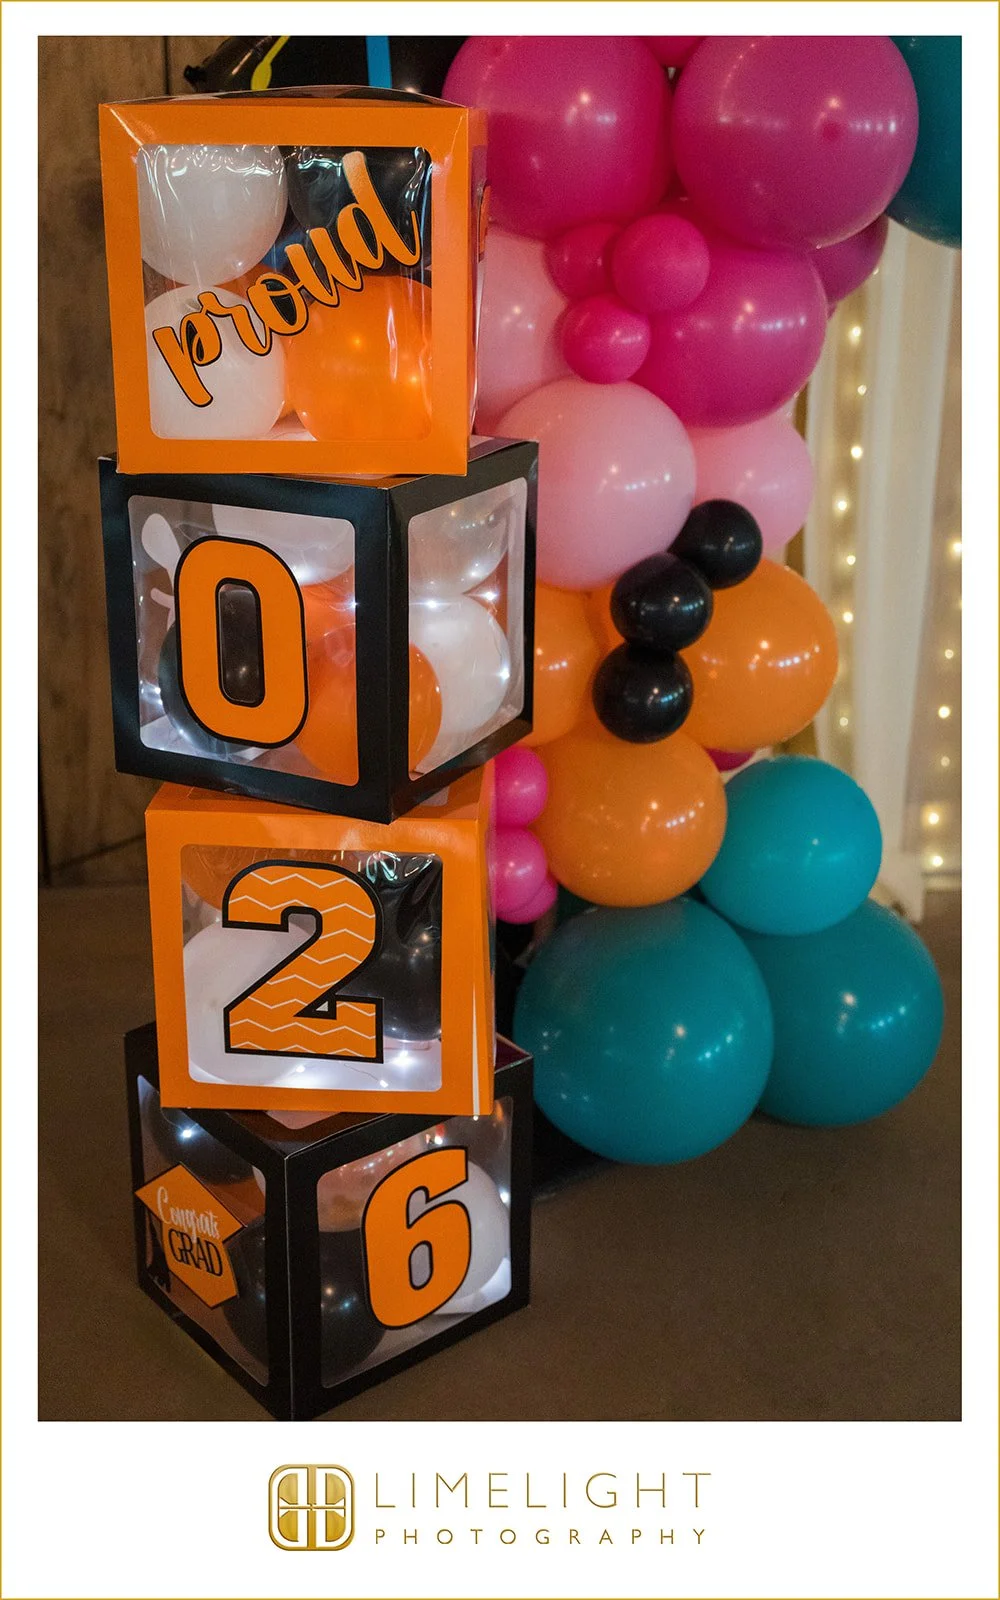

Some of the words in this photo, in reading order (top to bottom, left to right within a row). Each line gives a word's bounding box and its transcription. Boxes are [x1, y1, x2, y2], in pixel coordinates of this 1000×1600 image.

[152, 151, 421, 408] proud
[174, 535, 309, 749] 0
[222, 859, 384, 1064] 2
[157, 1186, 220, 1244] Congrats
[168, 1228, 223, 1277] GRAD
[361, 1145, 472, 1331] 6
